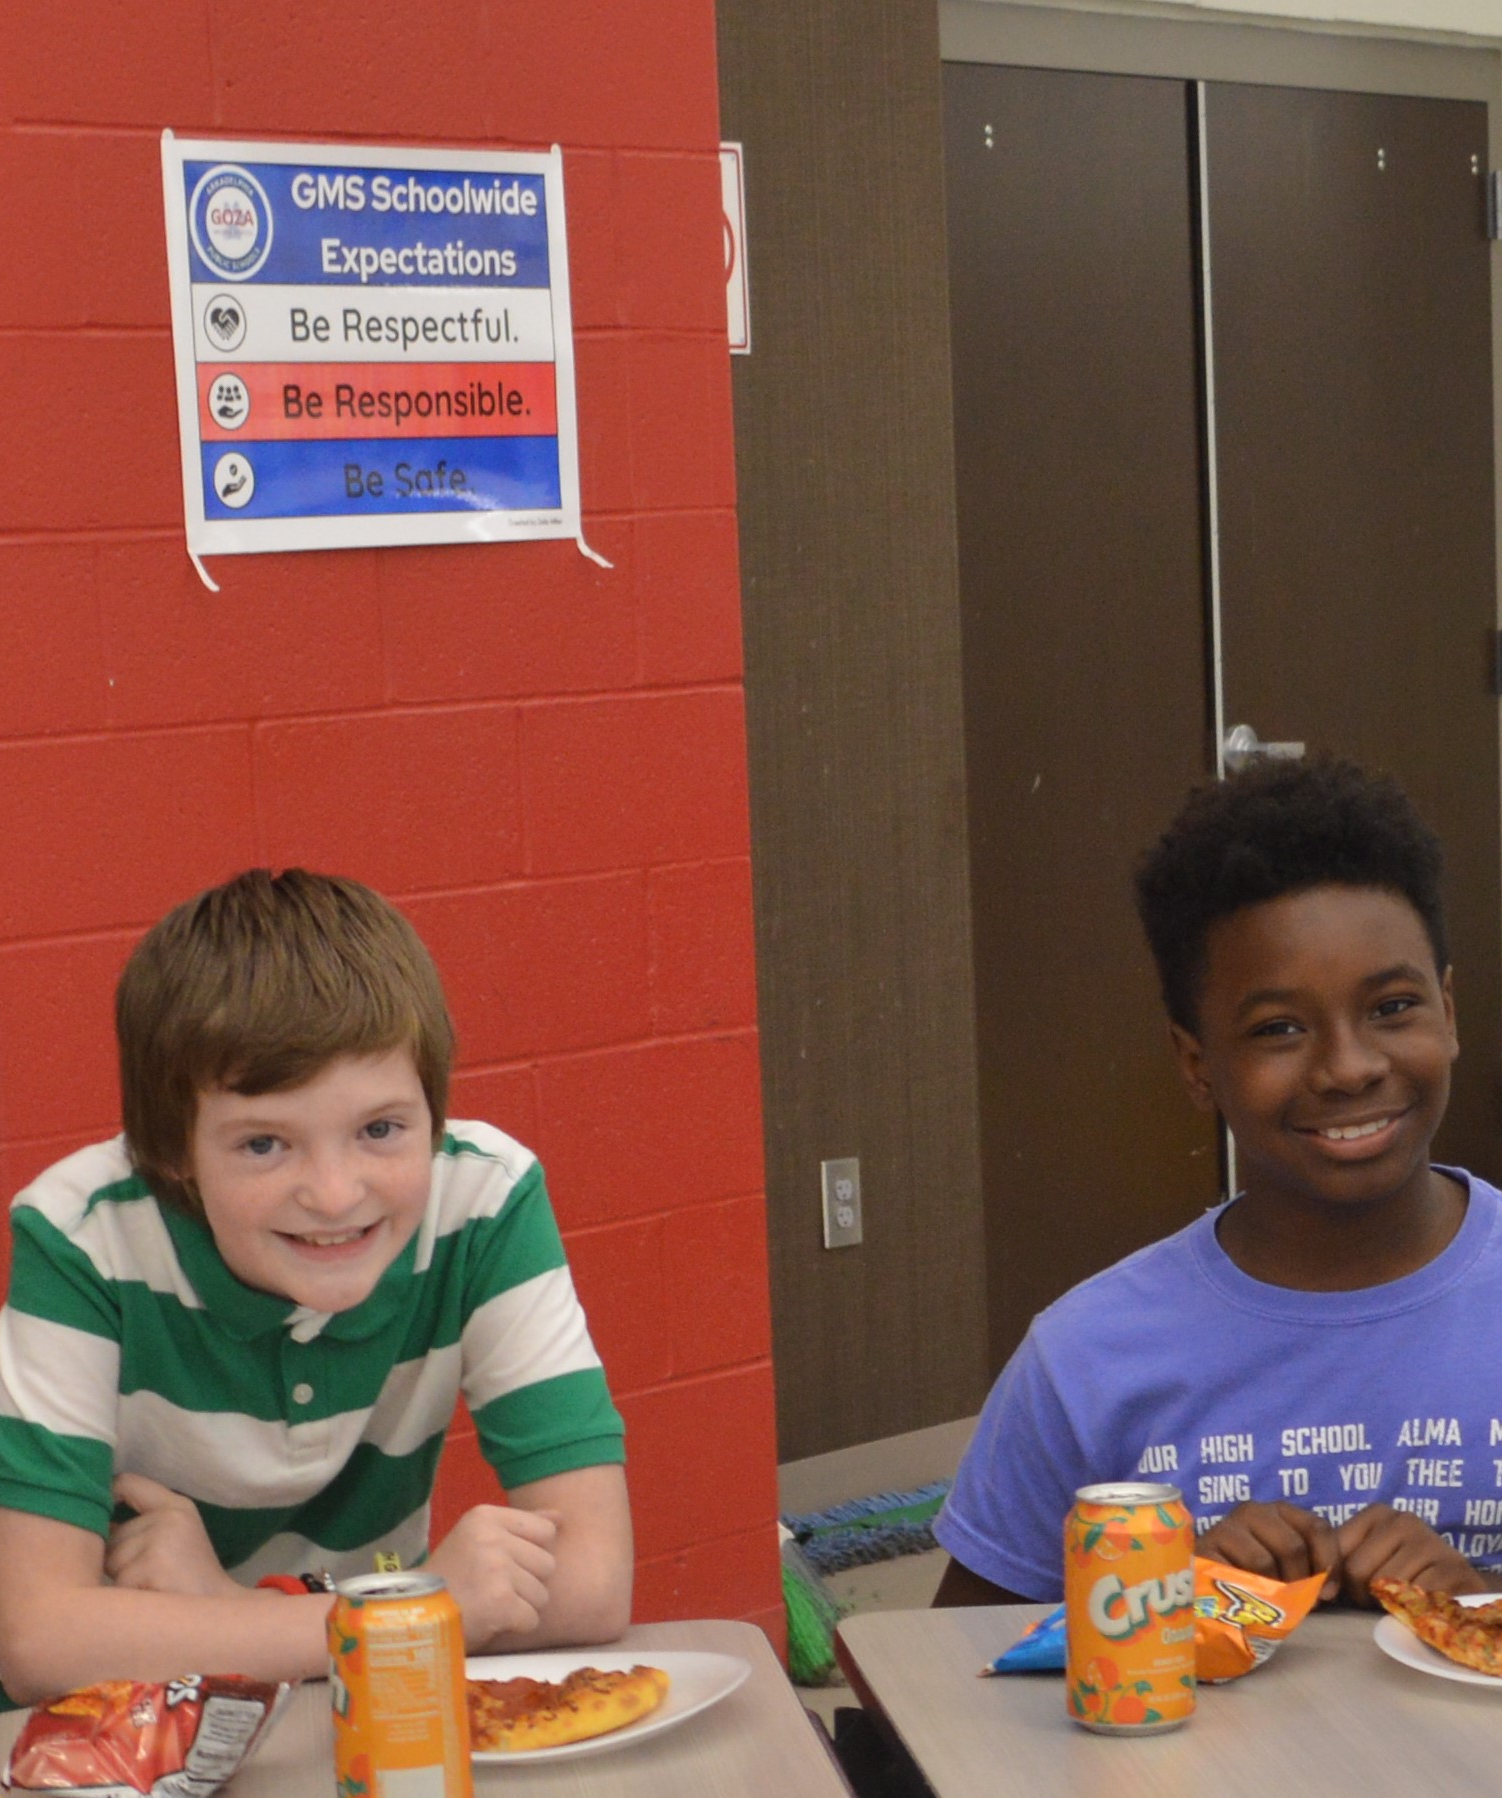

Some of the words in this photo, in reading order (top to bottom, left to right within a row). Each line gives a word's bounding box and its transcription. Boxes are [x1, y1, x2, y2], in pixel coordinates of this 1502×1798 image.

[291, 172, 366, 212] GMS
[371, 176, 538, 217] Schoolwide
[210, 208, 255, 228] GOZA
[320, 237, 518, 284] Expectations
[289, 307, 331, 343] Be
[342, 307, 519, 352] Respectful.
[282, 384, 324, 419] Be
[334, 381, 532, 427] Responsible.
[343, 463, 385, 498] Be
[393, 460, 477, 498] Safe.
[1200, 1434, 1254, 1464] HIGH
[1281, 1424, 1372, 1457] SCHOOL
[1396, 1418, 1462, 1447] ALMA
[1198, 1473, 1251, 1504] SING
[1278, 1467, 1310, 1497] TO
[1339, 1462, 1383, 1491] YOU
[1406, 1458, 1464, 1487] THEE
[1088, 1568, 1196, 1638] Crus
